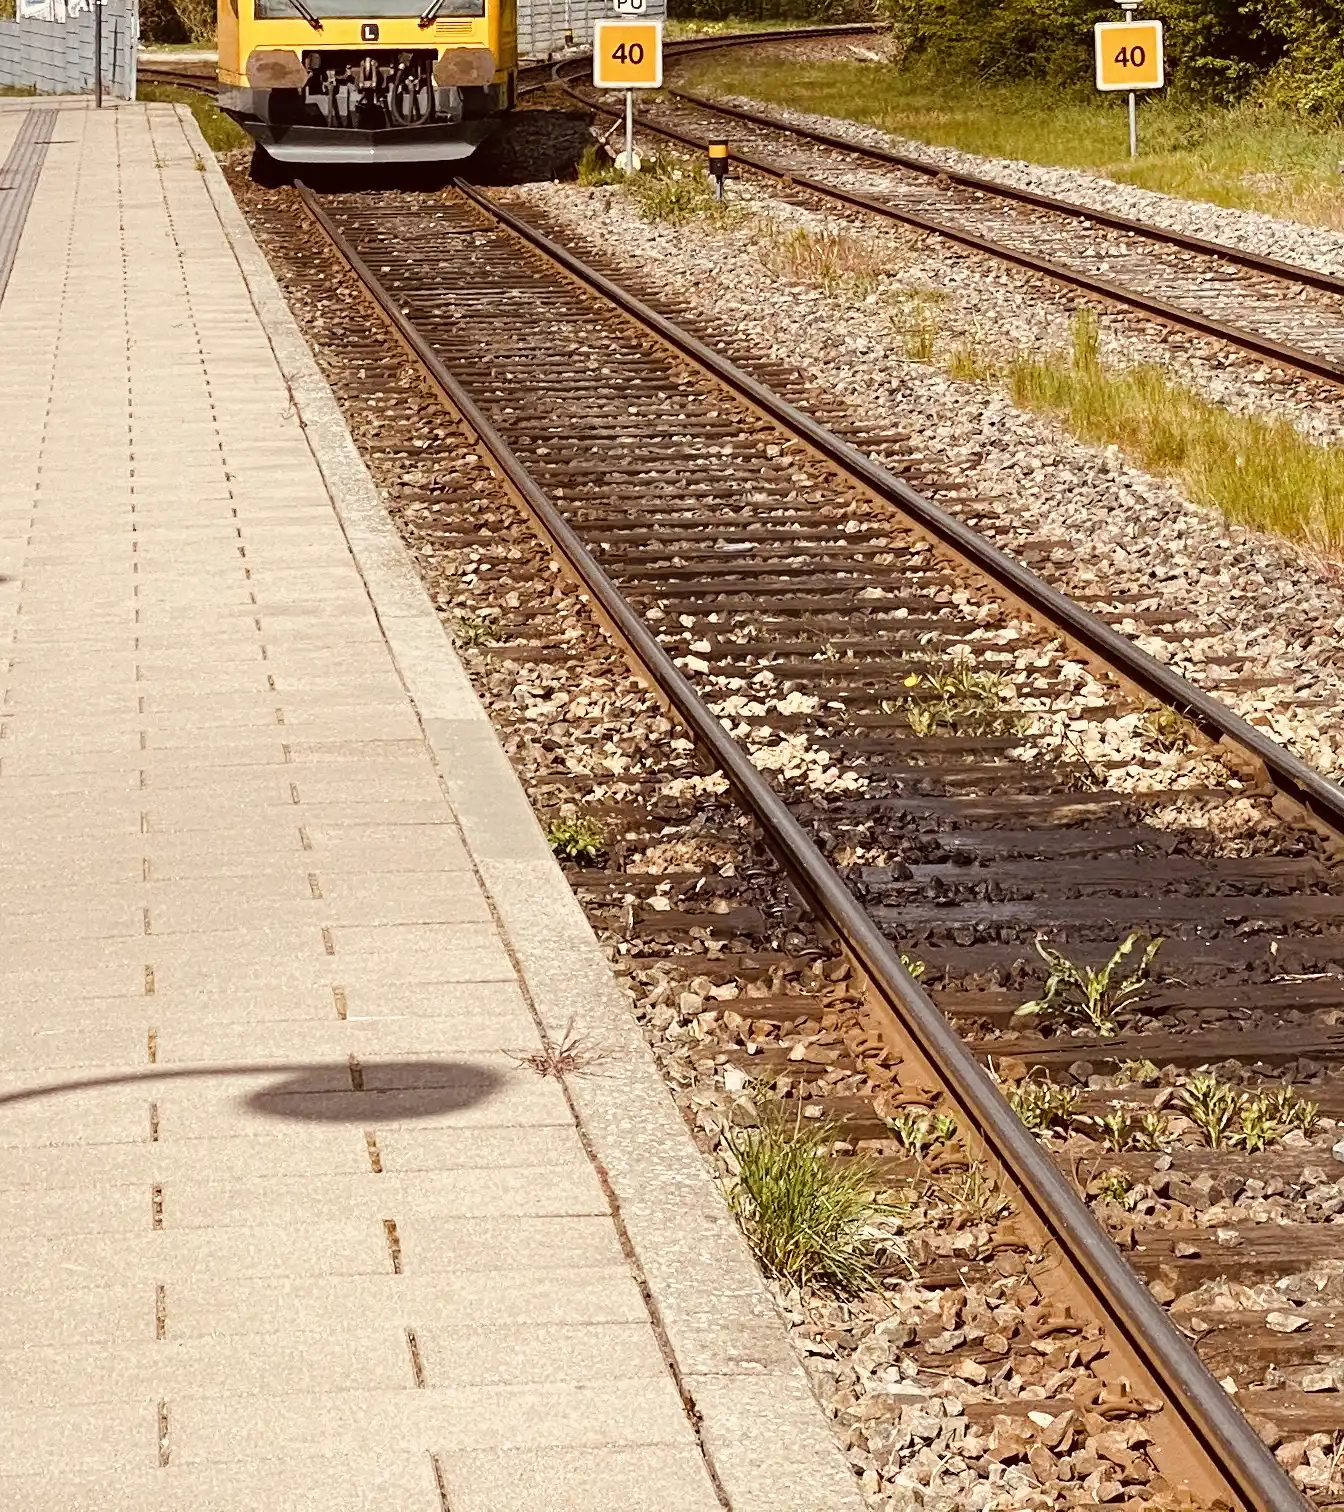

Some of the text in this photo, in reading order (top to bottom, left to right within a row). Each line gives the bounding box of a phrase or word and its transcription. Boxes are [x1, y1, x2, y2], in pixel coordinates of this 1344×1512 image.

[365, 26, 375, 39] L
[612, 43, 644, 64] 40
[1114, 46, 1146, 67] 40
